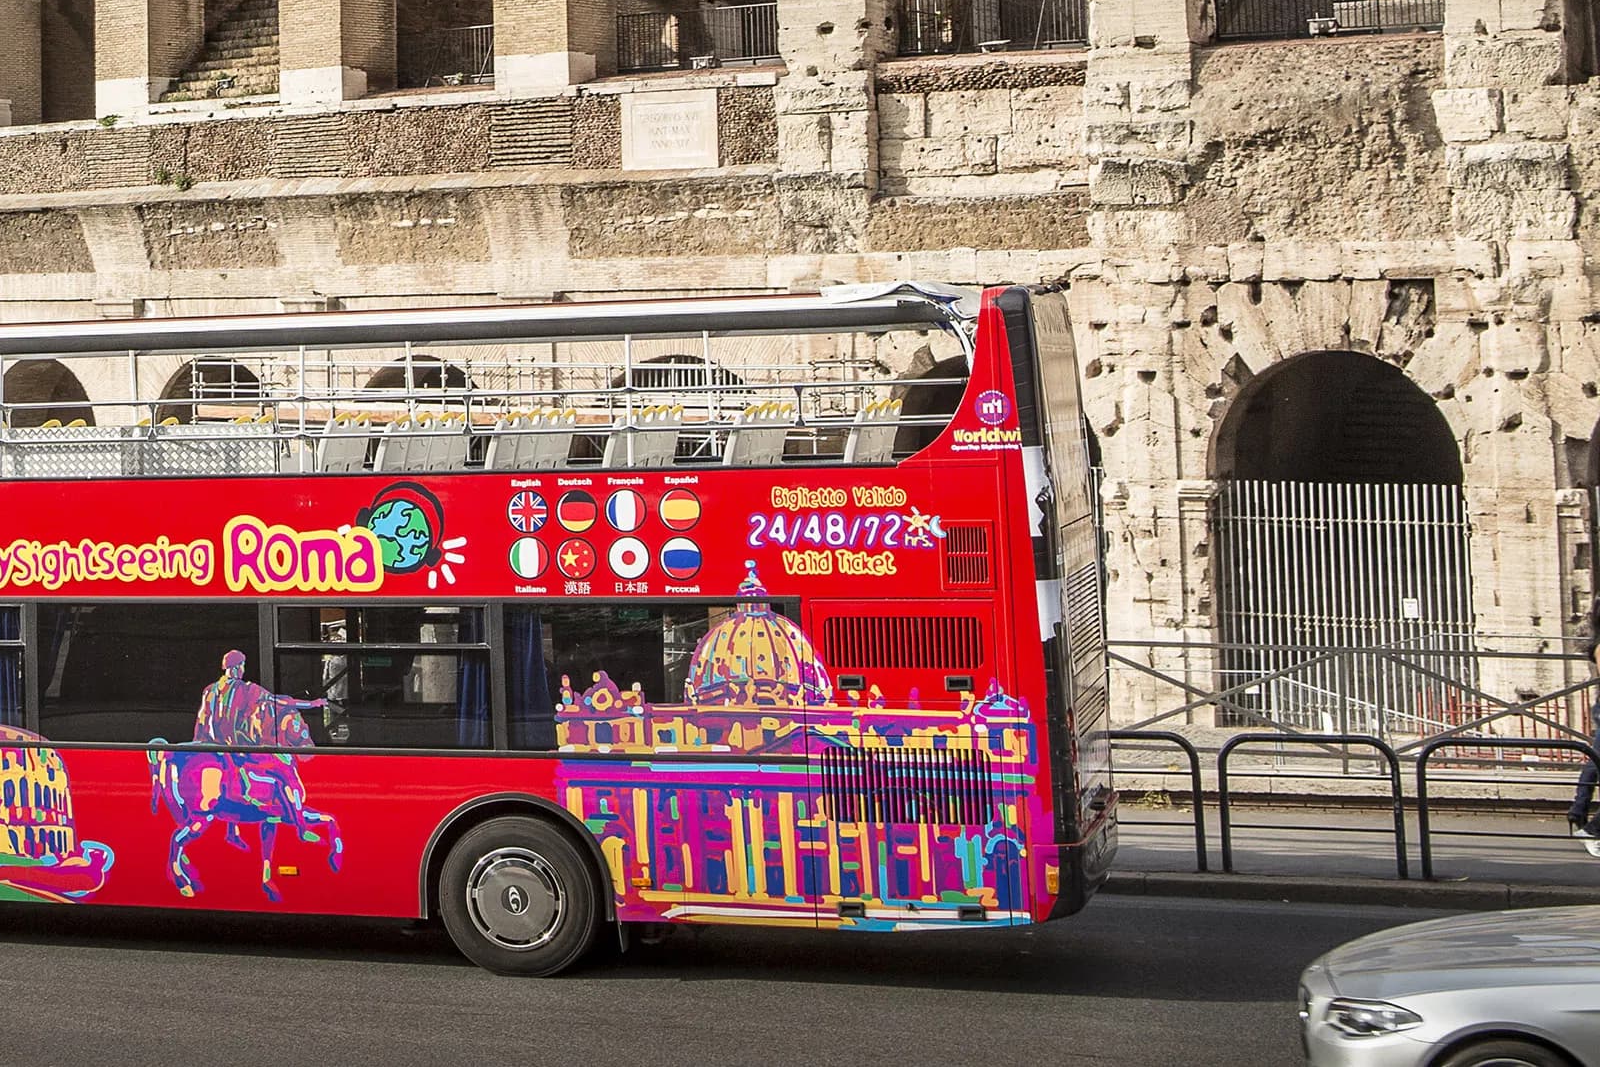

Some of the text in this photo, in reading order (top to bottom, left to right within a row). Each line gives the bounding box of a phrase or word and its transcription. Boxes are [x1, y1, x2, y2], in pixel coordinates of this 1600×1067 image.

[511, 479, 542, 488] English
[557, 478, 592, 486] Deutsch
[607, 476, 644, 486] Français
[664, 475, 699, 485] Español
[771, 486, 908, 511] Biglietto Valido
[749, 512, 902, 547] 24/48/72
[223, 514, 383, 593] Roma
[782, 548, 898, 576] Valid Ticket
[515, 585, 547, 593] Italiano
[565, 581, 591, 594] 漢語
[615, 581, 648, 593] 日本語
